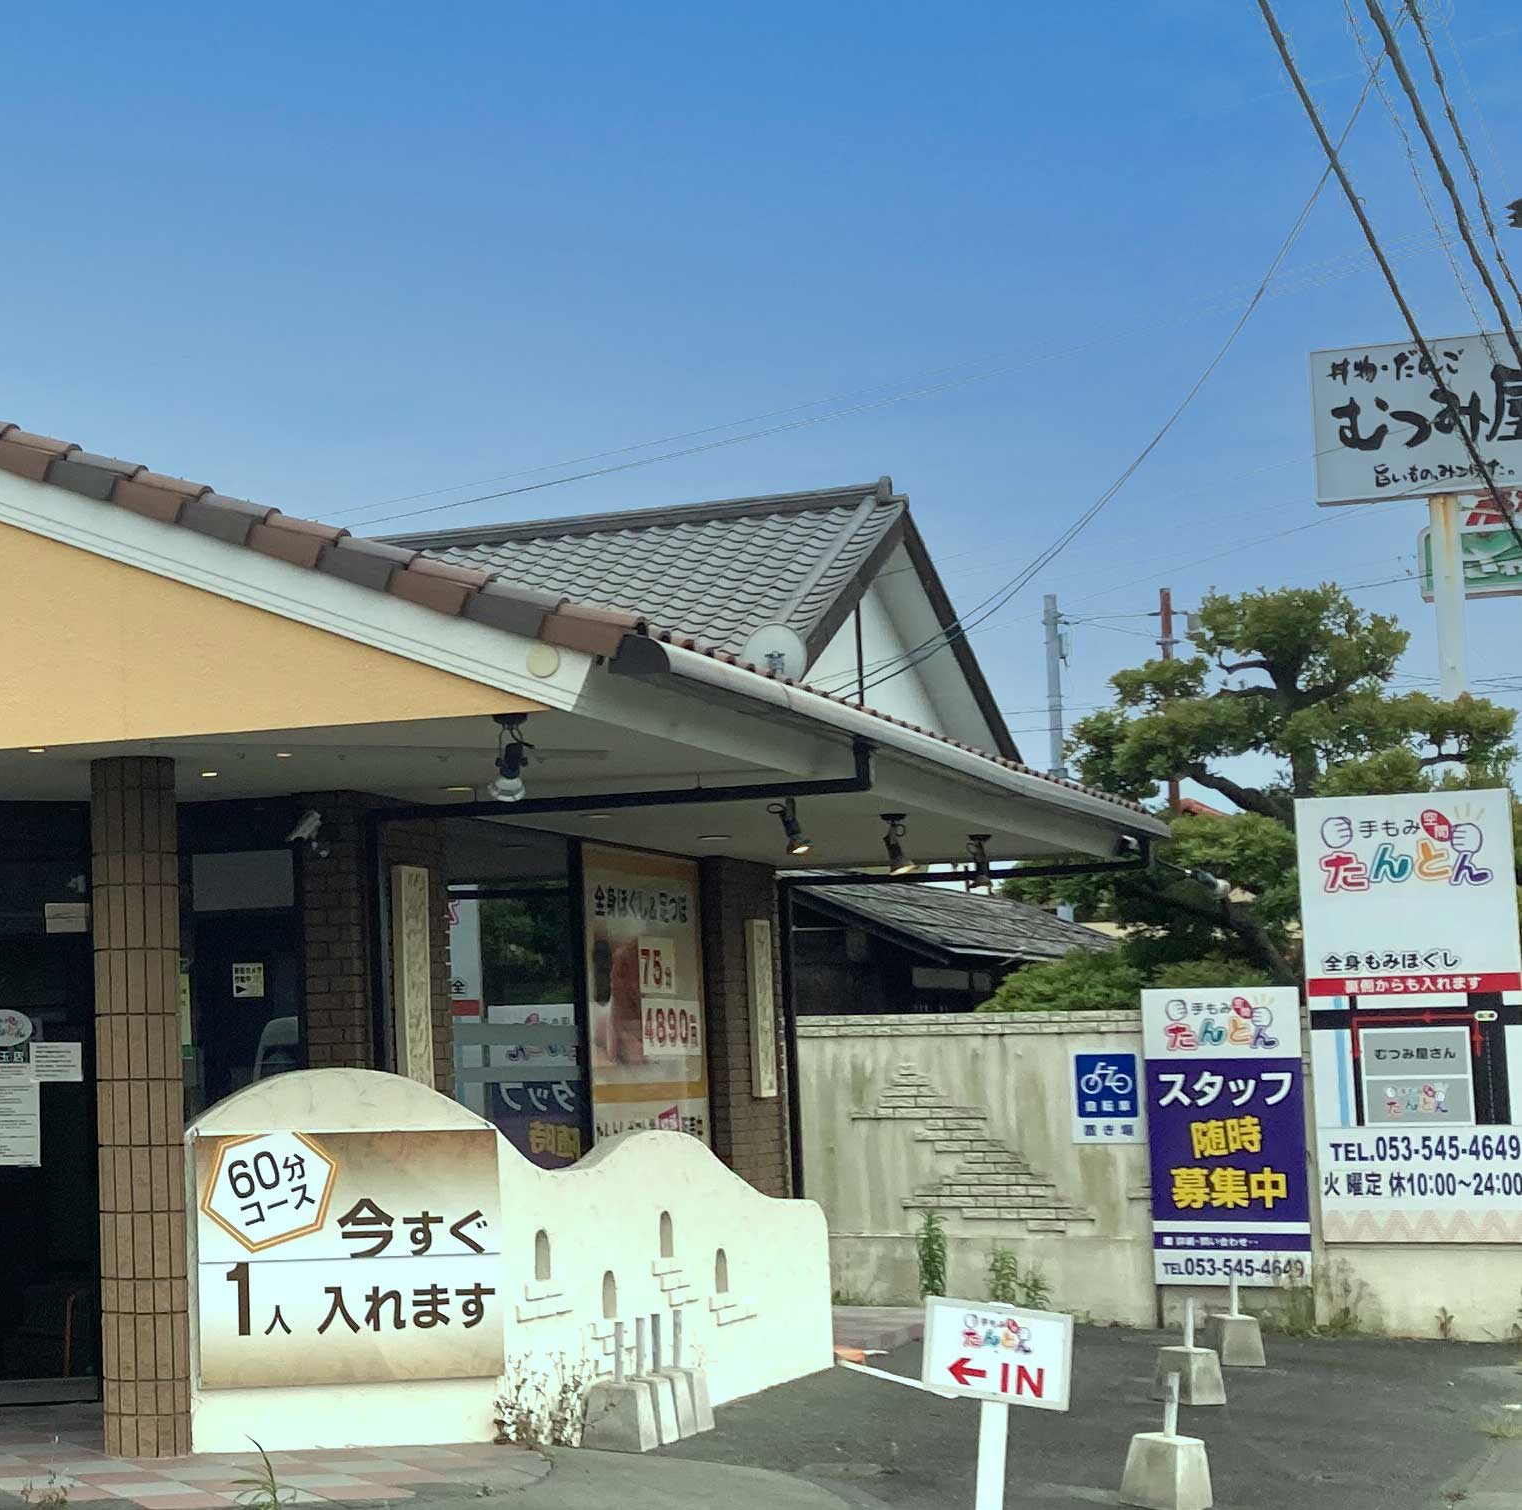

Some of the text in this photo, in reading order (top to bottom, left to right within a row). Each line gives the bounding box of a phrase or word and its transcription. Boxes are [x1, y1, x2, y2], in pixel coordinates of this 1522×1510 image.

[1359, 818, 1421, 839] 手もみ
[1320, 840, 1493, 892] たんとん
[1325, 951, 1459, 972] 全身もみほぐし
[1164, 1018, 1279, 1051] たんとん
[1375, 1047, 1457, 1060] むつみ屋さん
[1158, 1071, 1293, 1107] スタッフ
[1189, 1115, 1263, 1159] 随時
[1329, 1134, 1521, 1162] TEL.053-545-4649
[227, 1150, 306, 1199] 60分
[1170, 1166, 1288, 1210] 募集中
[240, 1184, 316, 1227] コース
[336, 1197, 489, 1259] 今すぐ
[316, 1282, 497, 1336] 入れます
[1000, 1362, 1045, 1399] IN
